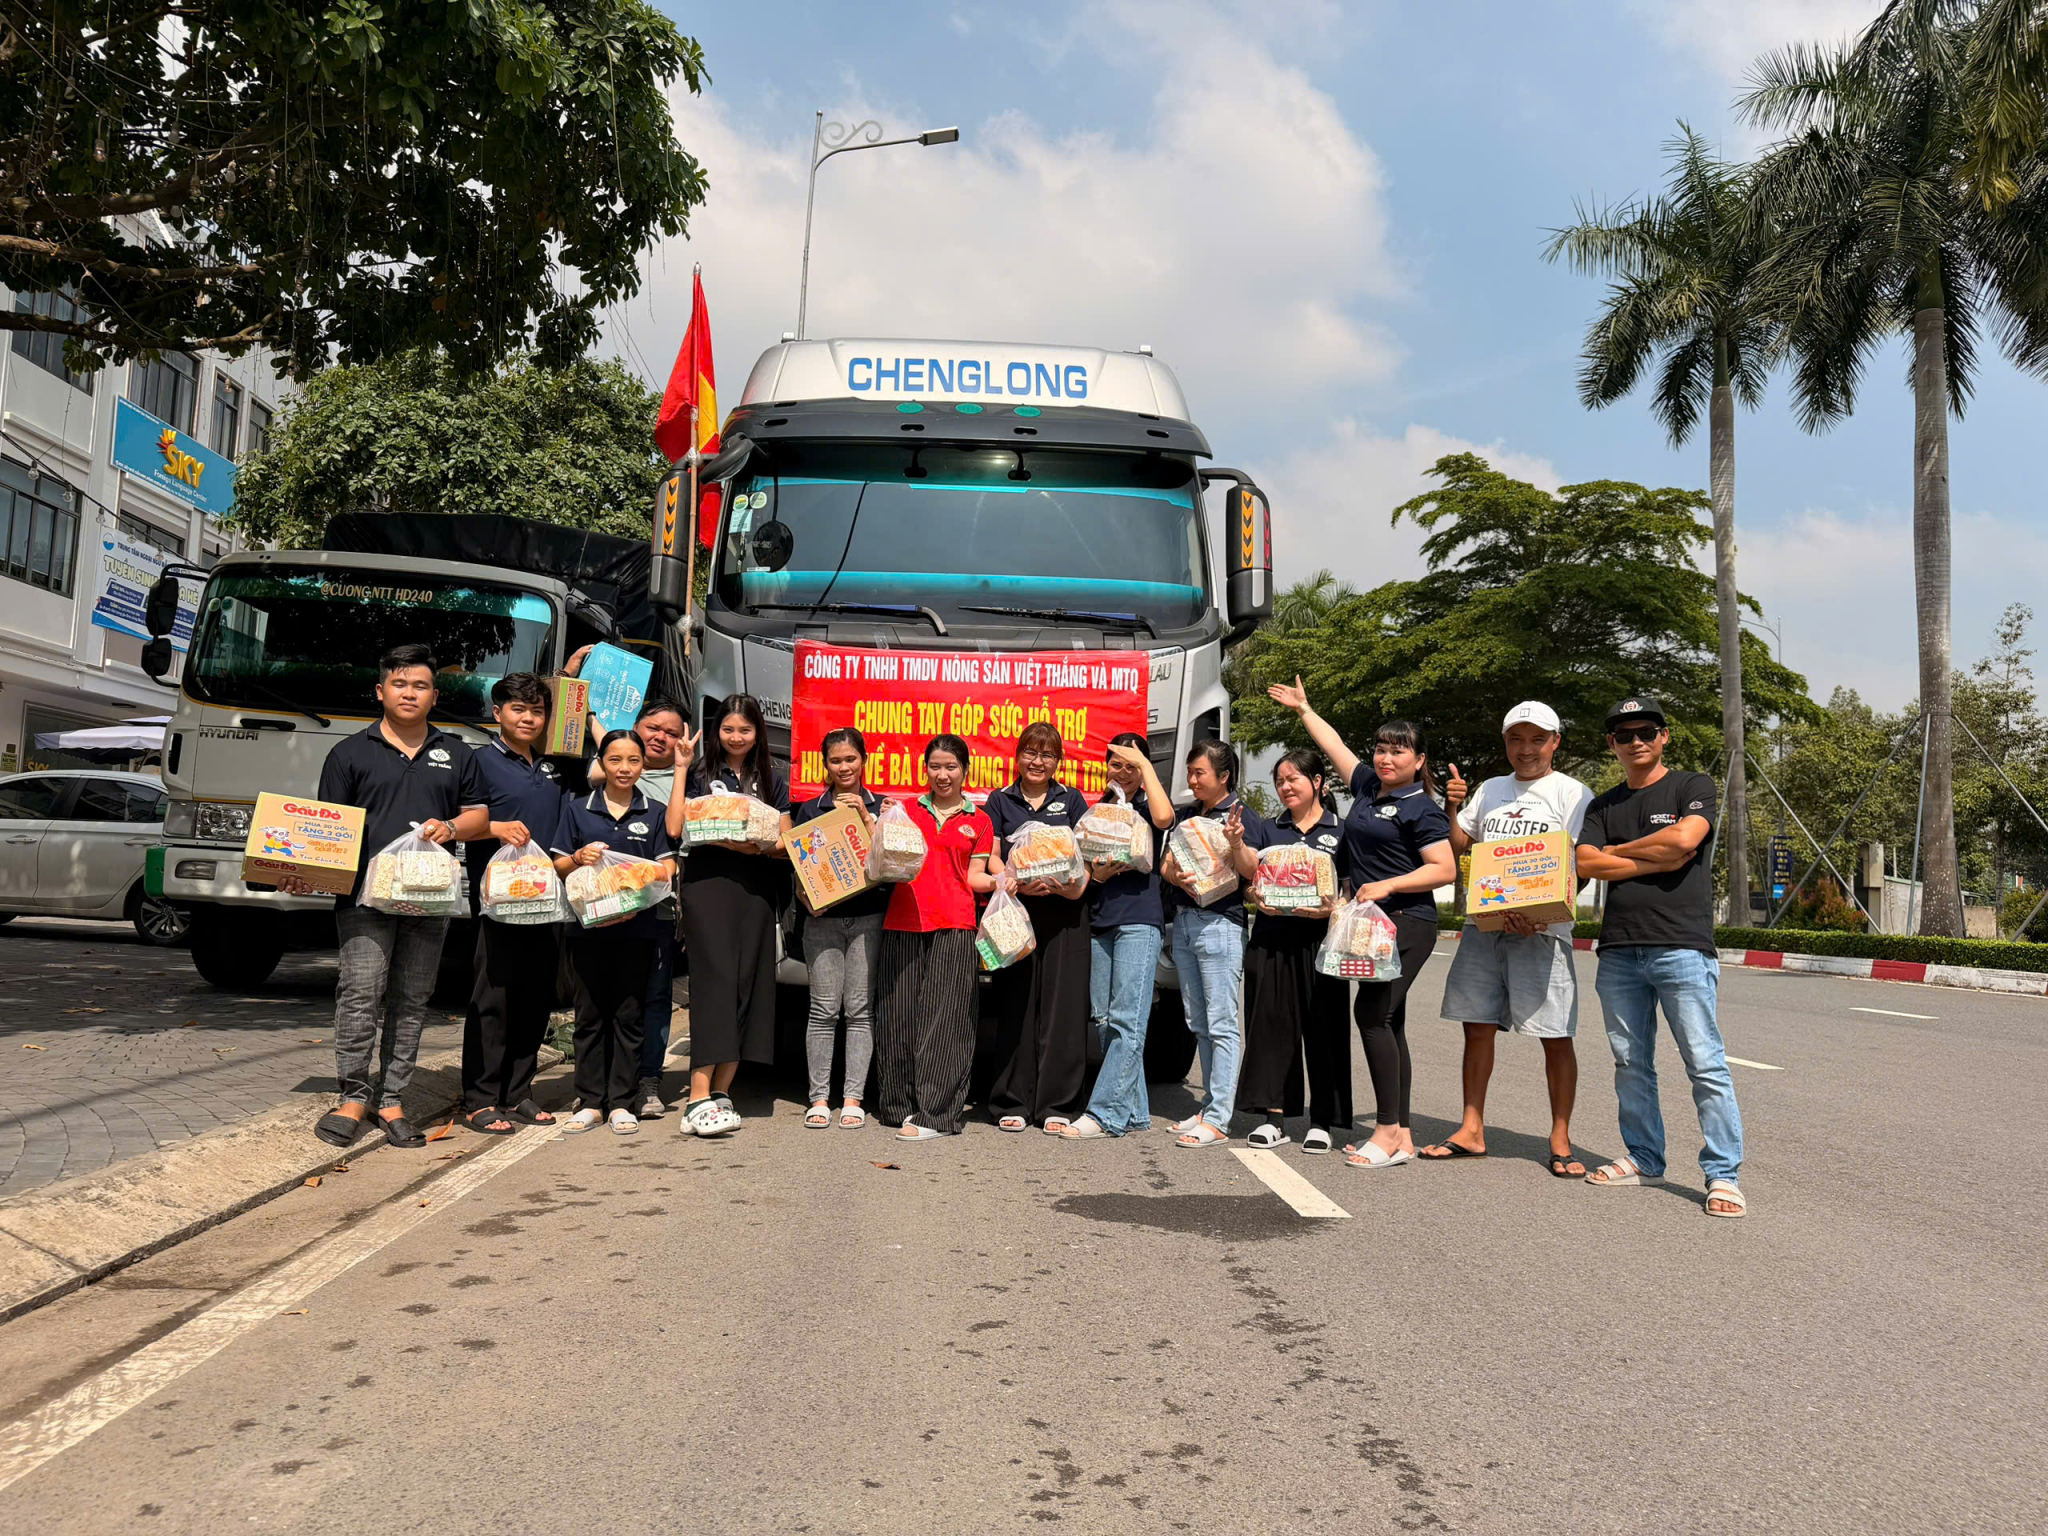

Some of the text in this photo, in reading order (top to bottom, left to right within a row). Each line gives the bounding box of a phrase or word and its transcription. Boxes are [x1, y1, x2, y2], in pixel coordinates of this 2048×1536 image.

[848, 357, 1087, 399] CHENGLONG
[163, 444, 205, 488] SKY
[153, 469, 172, 485] Foreign
[172, 477, 193, 496] Language
[104, 554, 135, 583] TUYỂN
[395, 588, 433, 603] HD240
[804, 650, 1139, 694] CÔNG TY TNHH TMDV NÔNG SẢN VIỆT THẮNG VÀ MTQ
[200, 727, 259, 741] HYUNDAI
[854, 700, 912, 734] CHUNG
[917, 702, 946, 735] TAY
[951, 697, 984, 737] GÓP
[989, 699, 1023, 739] SỨC
[1055, 706, 1088, 748] TRỢ
[864, 742, 885, 786] VỀ
[889, 747, 912, 786] BÀ
[962, 748, 1004, 789] ÙNG
[283, 802, 318, 817] Gấu
[319, 808, 342, 821] Đỏ
[297, 825, 324, 835] TẶNG
[335, 831, 353, 839] GÓI
[844, 823, 863, 851] Gấu
[1483, 817, 1549, 836] HOLLISTER
[1493, 840, 1545, 857] Gấu Đỏ
[830, 846, 843, 867] TẶNG
[843, 874, 853, 887] GÓI
[1507, 865, 1531, 875] TẶNG
[1541, 861, 1557, 869] GÓI
